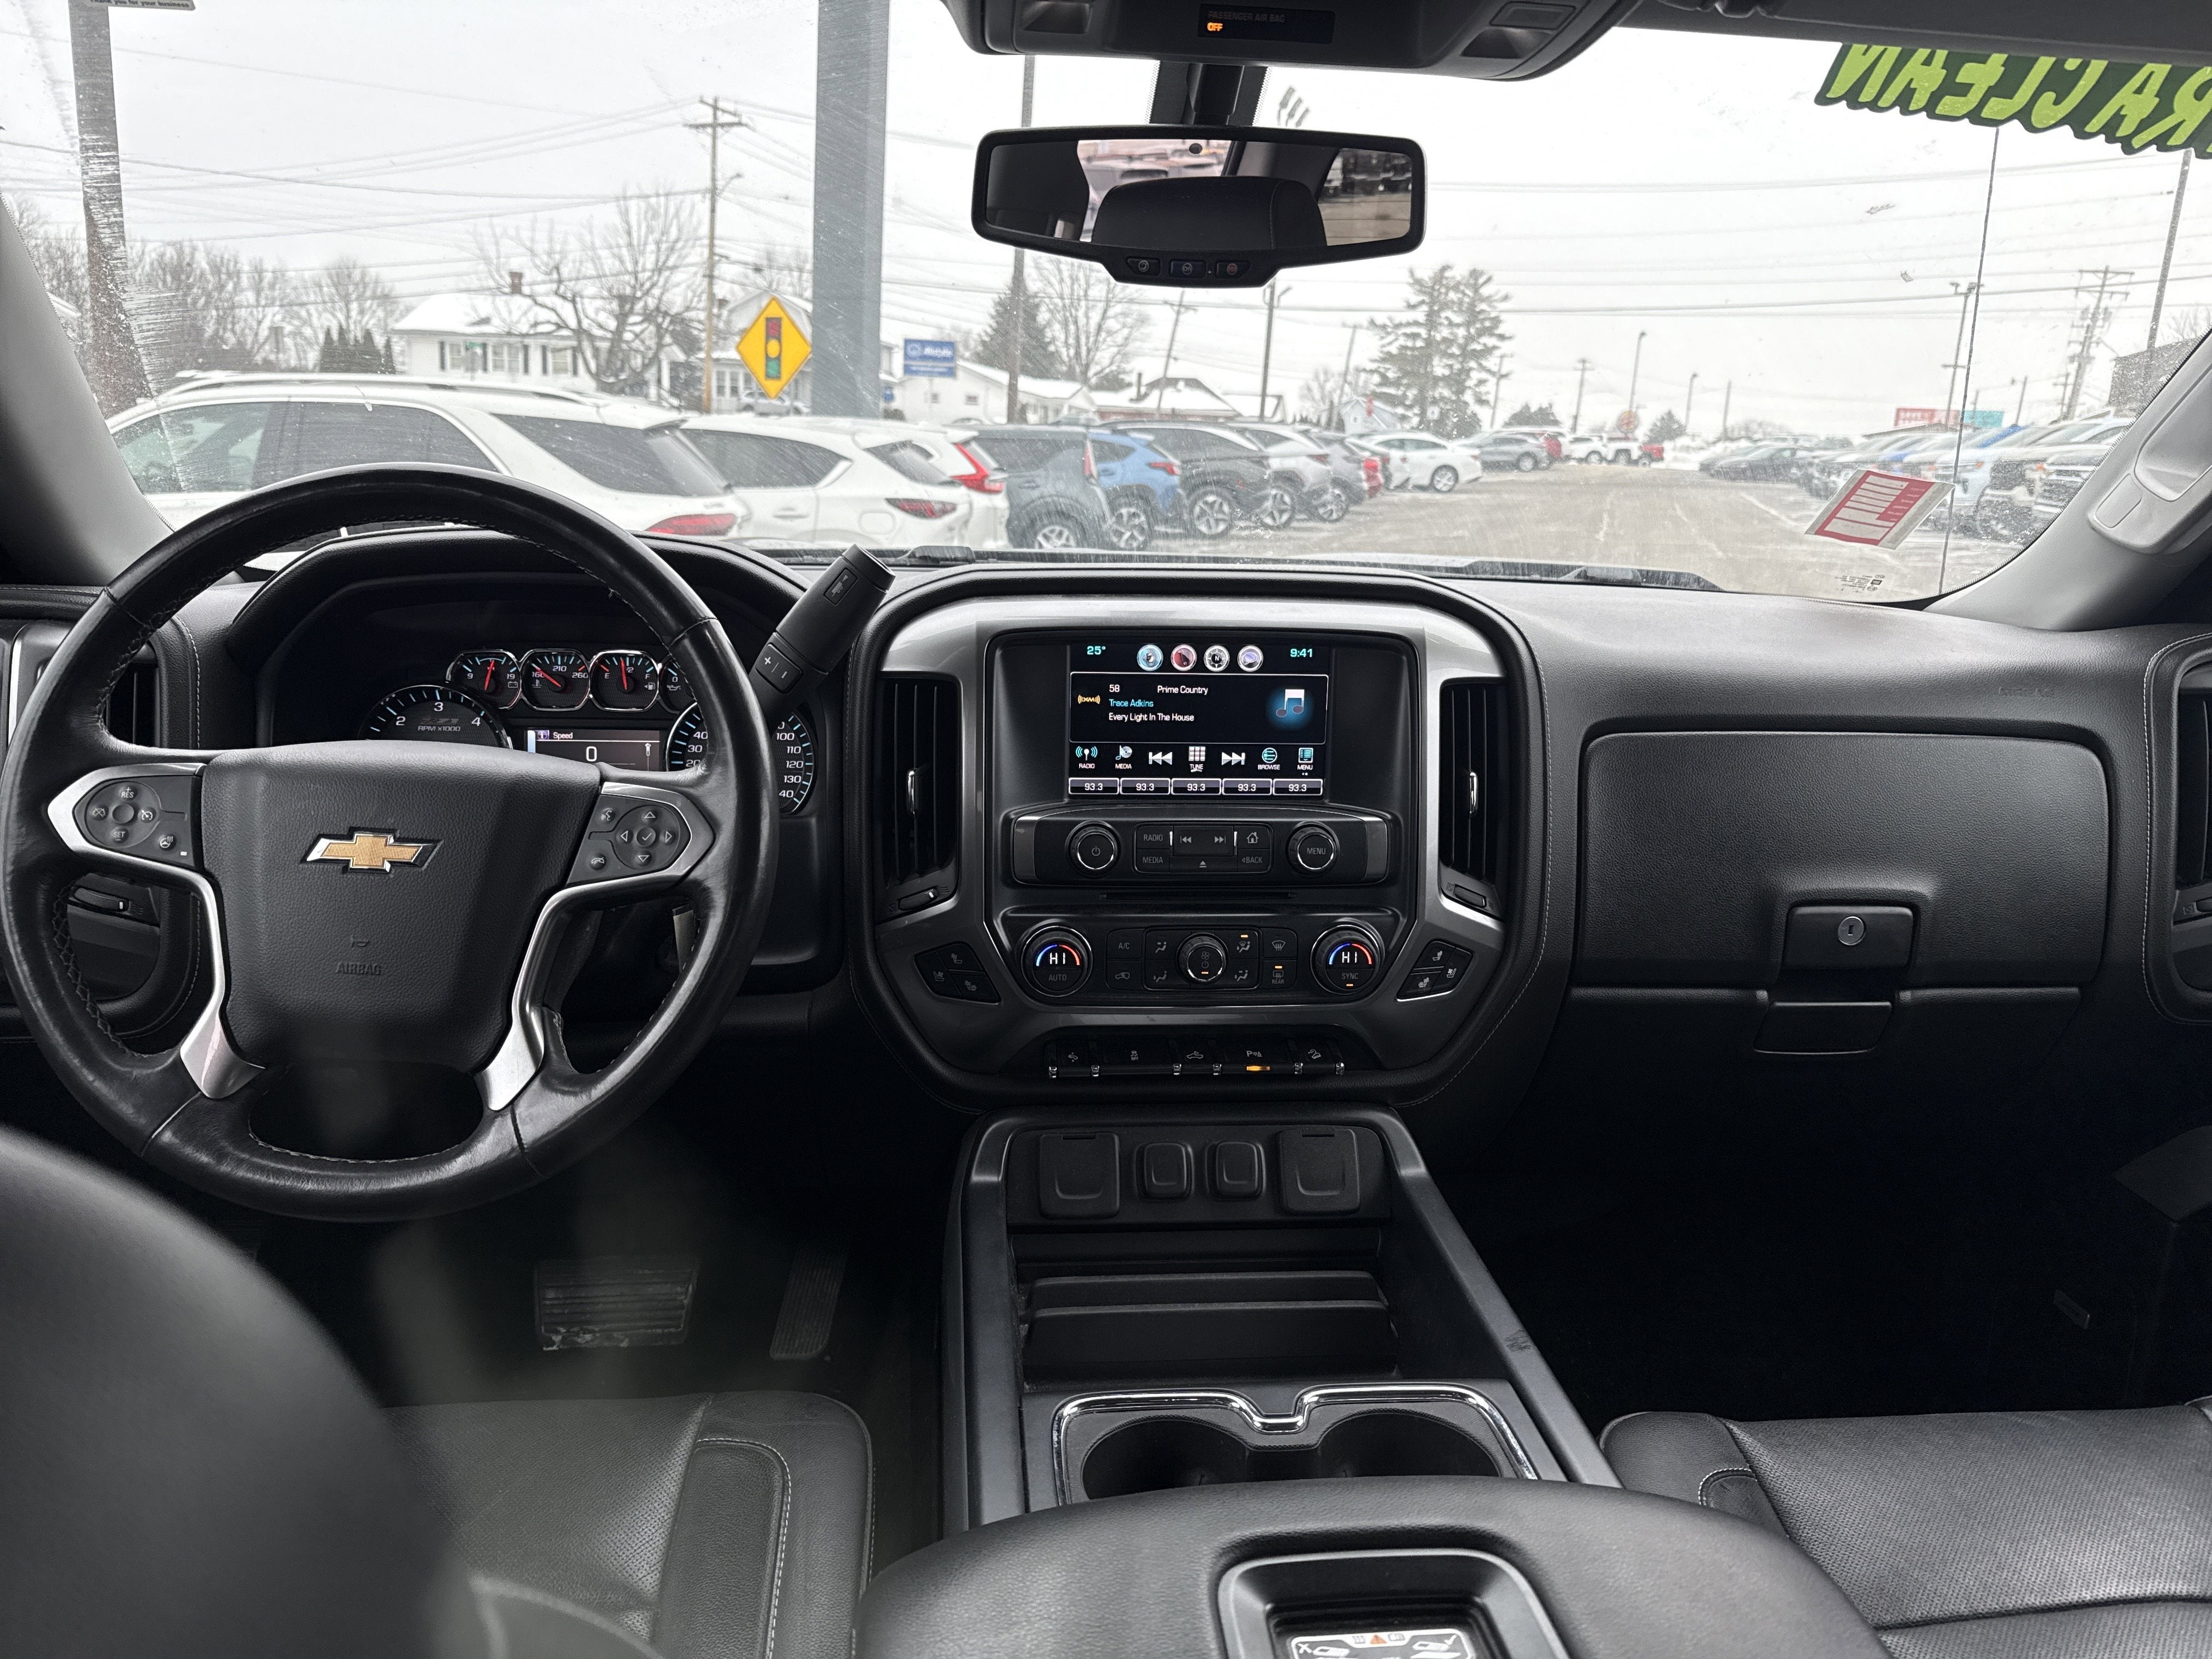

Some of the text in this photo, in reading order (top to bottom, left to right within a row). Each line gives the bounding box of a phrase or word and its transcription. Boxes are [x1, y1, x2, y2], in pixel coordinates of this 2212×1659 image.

[1208, 11, 1285, 22] PASSENGER AIR BAG
[1207, 22, 1223, 31] OFF
[1087, 646, 1106, 655] 25°
[1290, 648, 1312, 658] 9:41
[1109, 684, 1120, 692] 58
[1157, 685, 1209, 696] Prime Country
[434, 702, 443, 712] 3
[1109, 698, 1154, 707] Trace Adkins
[396, 716, 406, 726] 2
[471, 716, 481, 726] 4
[1109, 712, 1128, 722] Every
[1130, 713, 1148, 722] Light
[1157, 713, 1170, 721] The
[1172, 713, 1194, 721] House
[553, 731, 573, 740] Speed
[693, 731, 708, 740] 40
[776, 732, 795, 741] 100
[687, 744, 703, 753] 30
[586, 746, 597, 761] 0
[1084, 783, 1103, 791] 93.3
[1136, 783, 1154, 791] 93.3
[1238, 783, 1256, 792] 93.3
[778, 790, 794, 798] 40
[1049, 952, 1066, 964] HI
[1341, 951, 1357, 963] HI
[335, 962, 382, 975] AIRBAG
